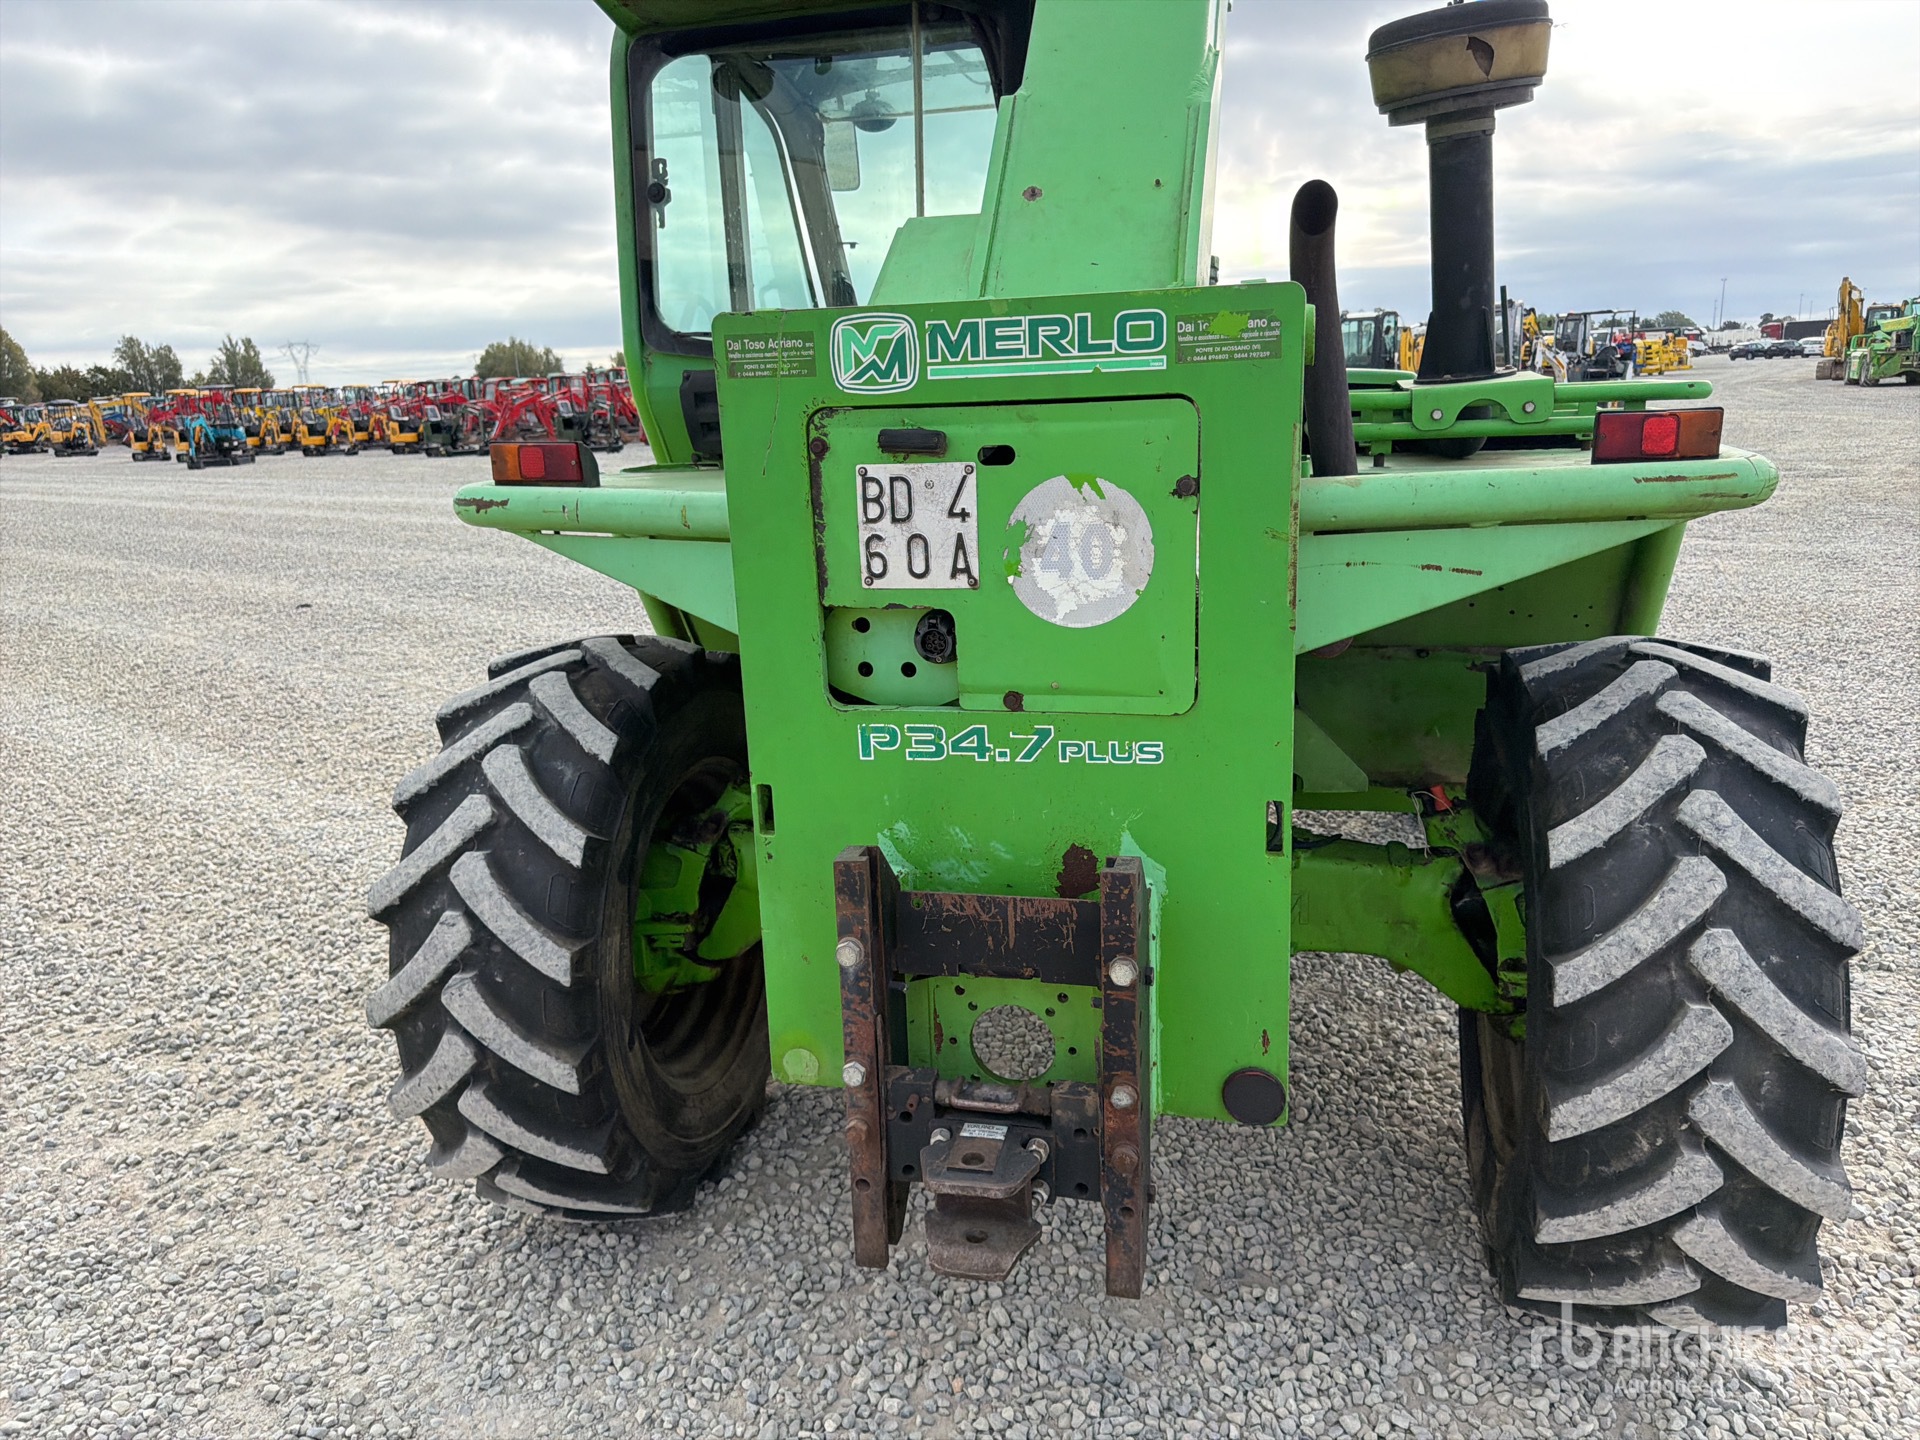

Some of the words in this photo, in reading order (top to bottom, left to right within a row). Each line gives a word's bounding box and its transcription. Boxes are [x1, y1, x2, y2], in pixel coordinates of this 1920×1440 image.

[726, 340, 742, 351] Dal
[743, 339, 766, 350] Toso
[925, 309, 1166, 362] MERLO
[1222, 344, 1250, 352] MOSSANO
[862, 475, 913, 524] BD
[947, 474, 971, 523] 4
[1039, 521, 1115, 581] 40
[857, 723, 1055, 762] P34.7
[1058, 740, 1164, 764] PLUS
